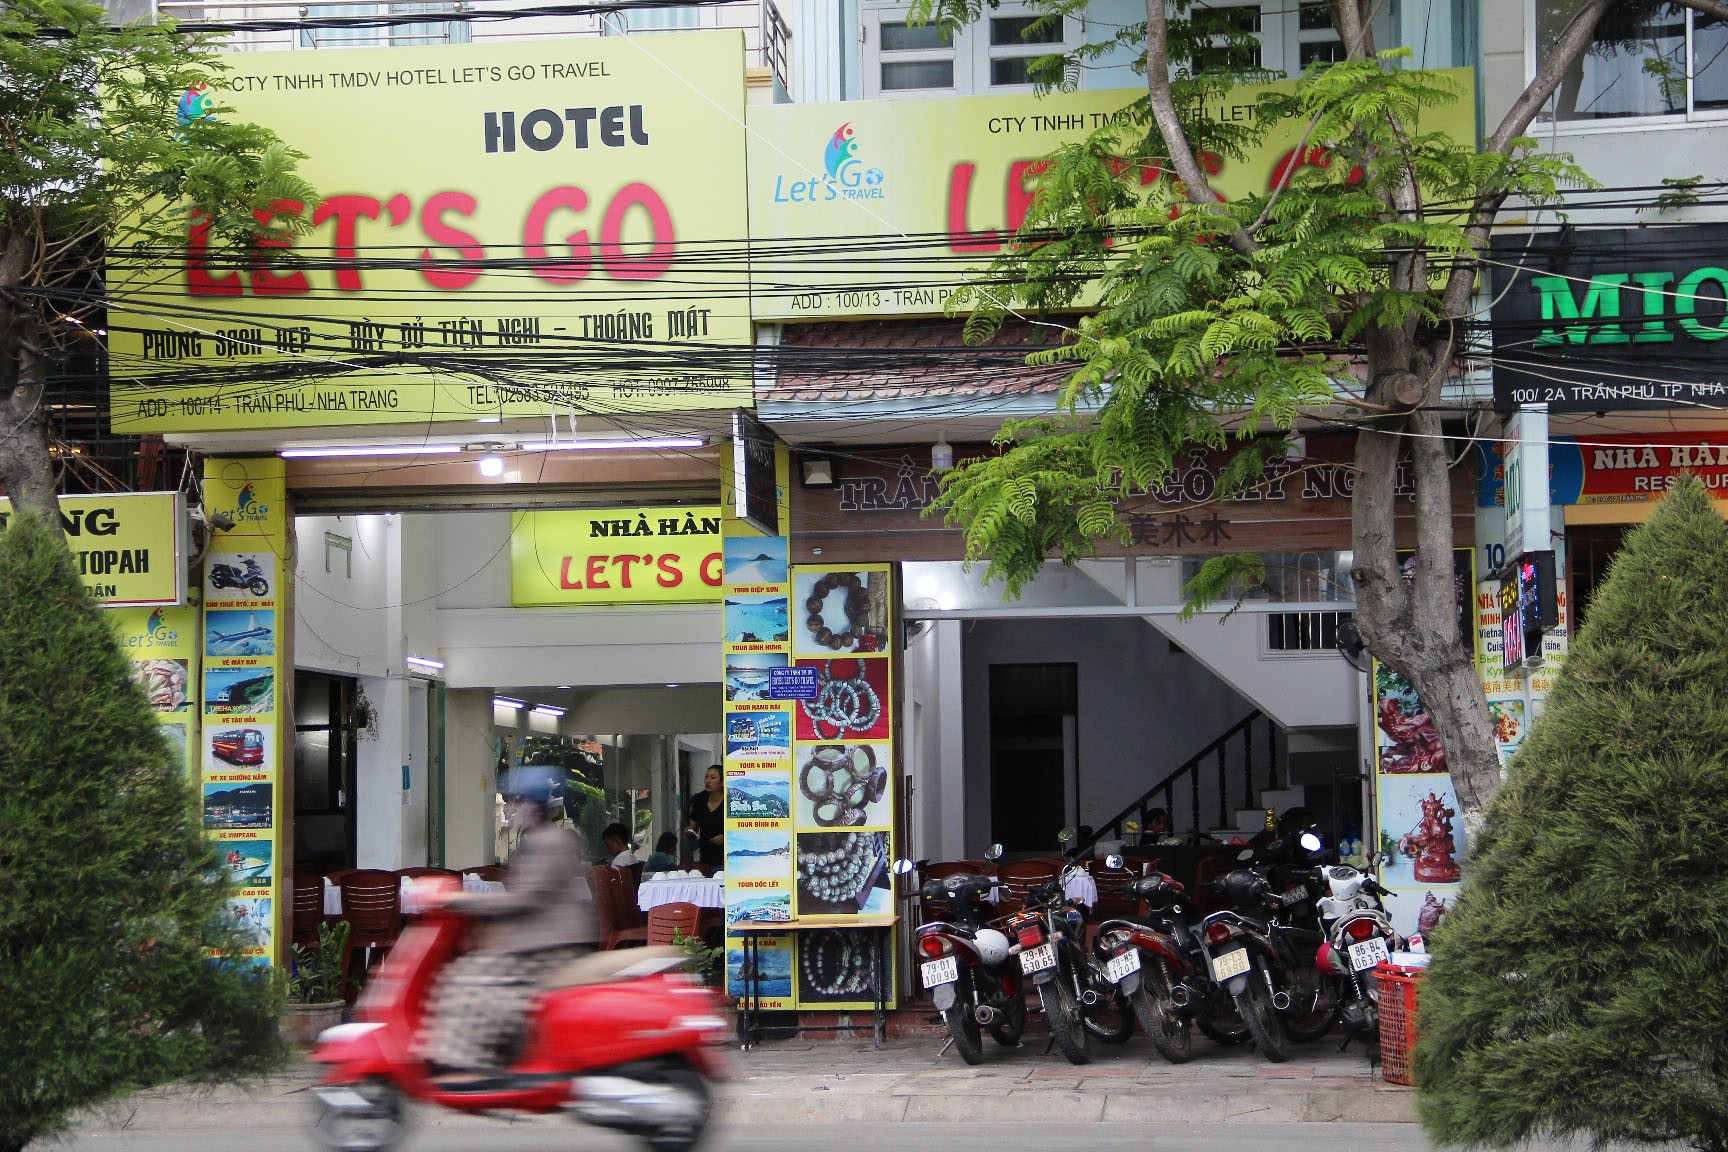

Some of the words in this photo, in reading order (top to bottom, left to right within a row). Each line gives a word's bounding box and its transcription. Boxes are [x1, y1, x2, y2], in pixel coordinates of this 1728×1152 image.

[232, 76, 267, 92] CTY
[273, 74, 324, 90] TNHH
[329, 72, 381, 88] TMDV
[387, 70, 447, 86] HOTEL
[452, 66, 501, 83] LET'S
[507, 64, 535, 81] GO
[541, 61, 610, 79] TRAVEL
[484, 104, 649, 153] HOTEL
[988, 117, 1026, 134] CTY
[1031, 115, 1085, 132] TNHH
[774, 173, 838, 202] Let's
[842, 187, 885, 200] TRAVEL
[184, 190, 485, 297] LET'S
[522, 181, 676, 287] GO
[792, 295, 823, 310] ADD
[835, 292, 881, 308] 100/13
[498, 317, 541, 345] NGHI
[579, 309, 653, 340] THOÁNG
[667, 305, 711, 341] MÁT
[317, 391, 347, 410] NHA
[350, 389, 398, 410] TRANG
[1511, 388, 1539, 402] 100/
[1545, 387, 1566, 401] 2A
[1622, 382, 1655, 399] PHÚ
[1661, 384, 1682, 397] TP
[1669, 439, 1728, 468] HÀ
[590, 512, 654, 537] NHÀ
[560, 553, 683, 589] LET'S
[1113, 961, 1136, 980] 1201
